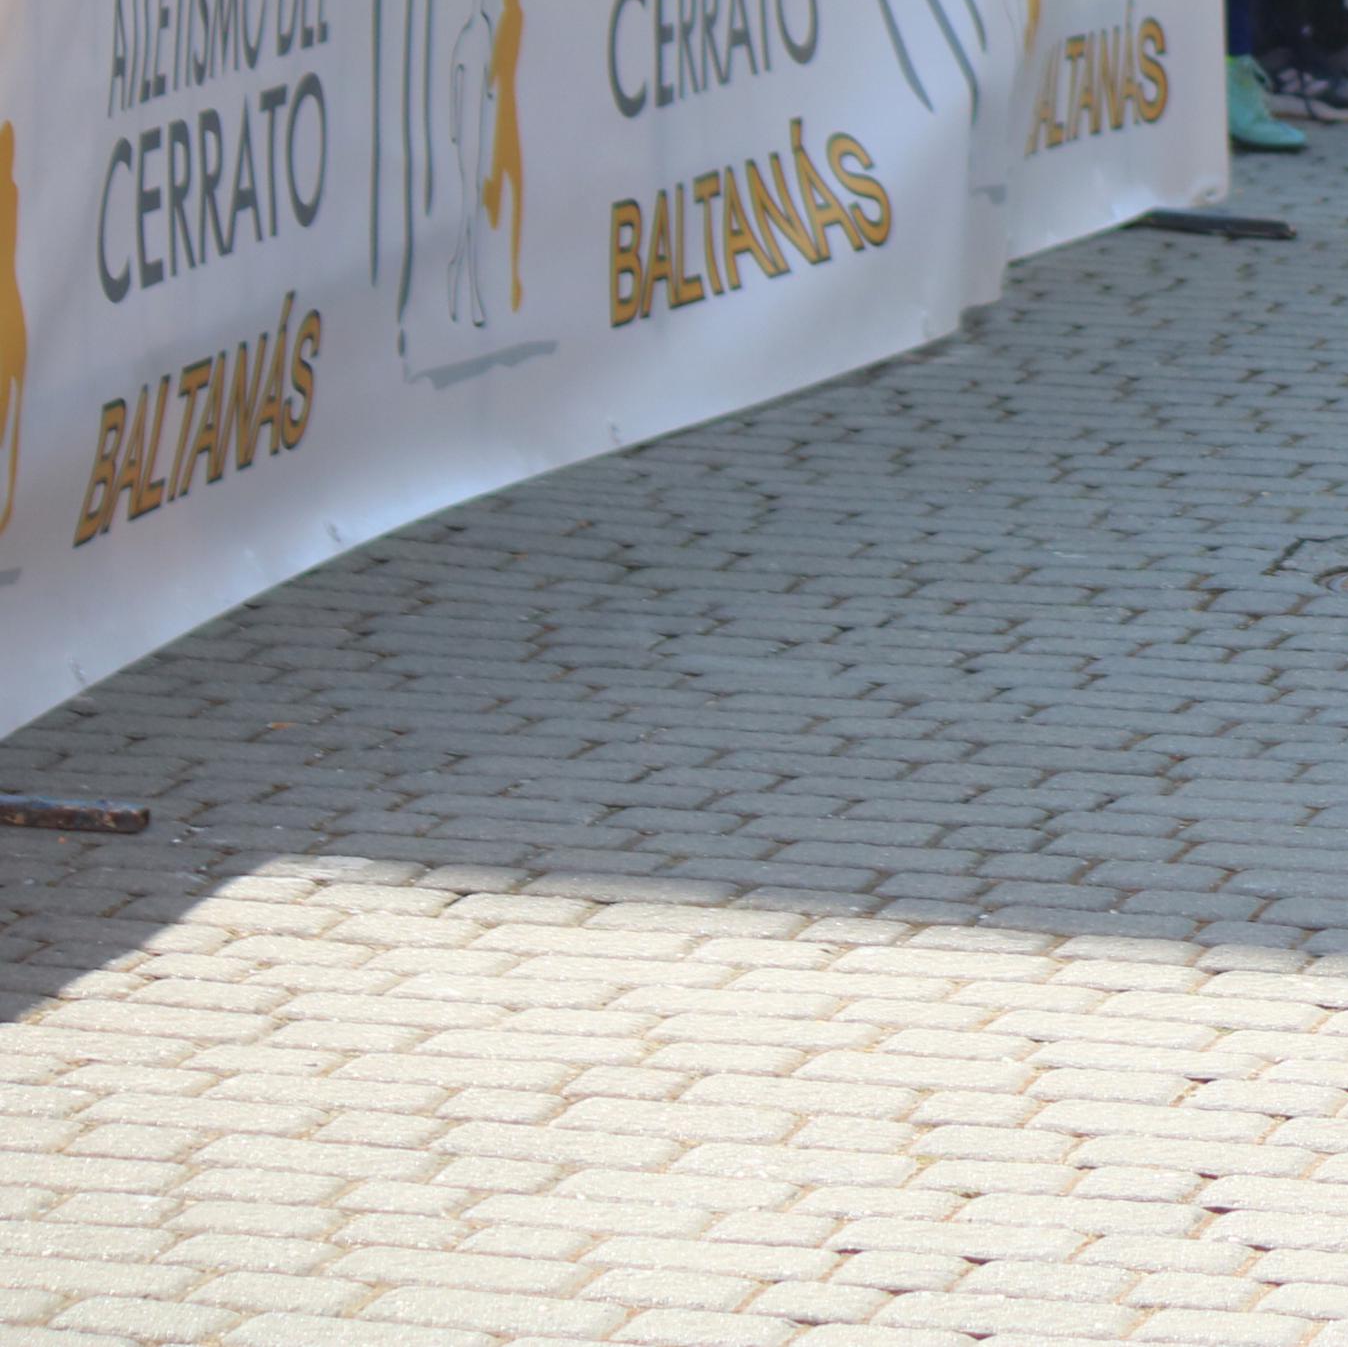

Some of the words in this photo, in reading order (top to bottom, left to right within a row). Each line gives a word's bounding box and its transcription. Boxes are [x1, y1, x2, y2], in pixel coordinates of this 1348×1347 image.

[98, 71, 327, 305] CERRATO
[610, 118, 893, 328] BALTANÁS
[73, 290, 322, 548] BALTANÁS
